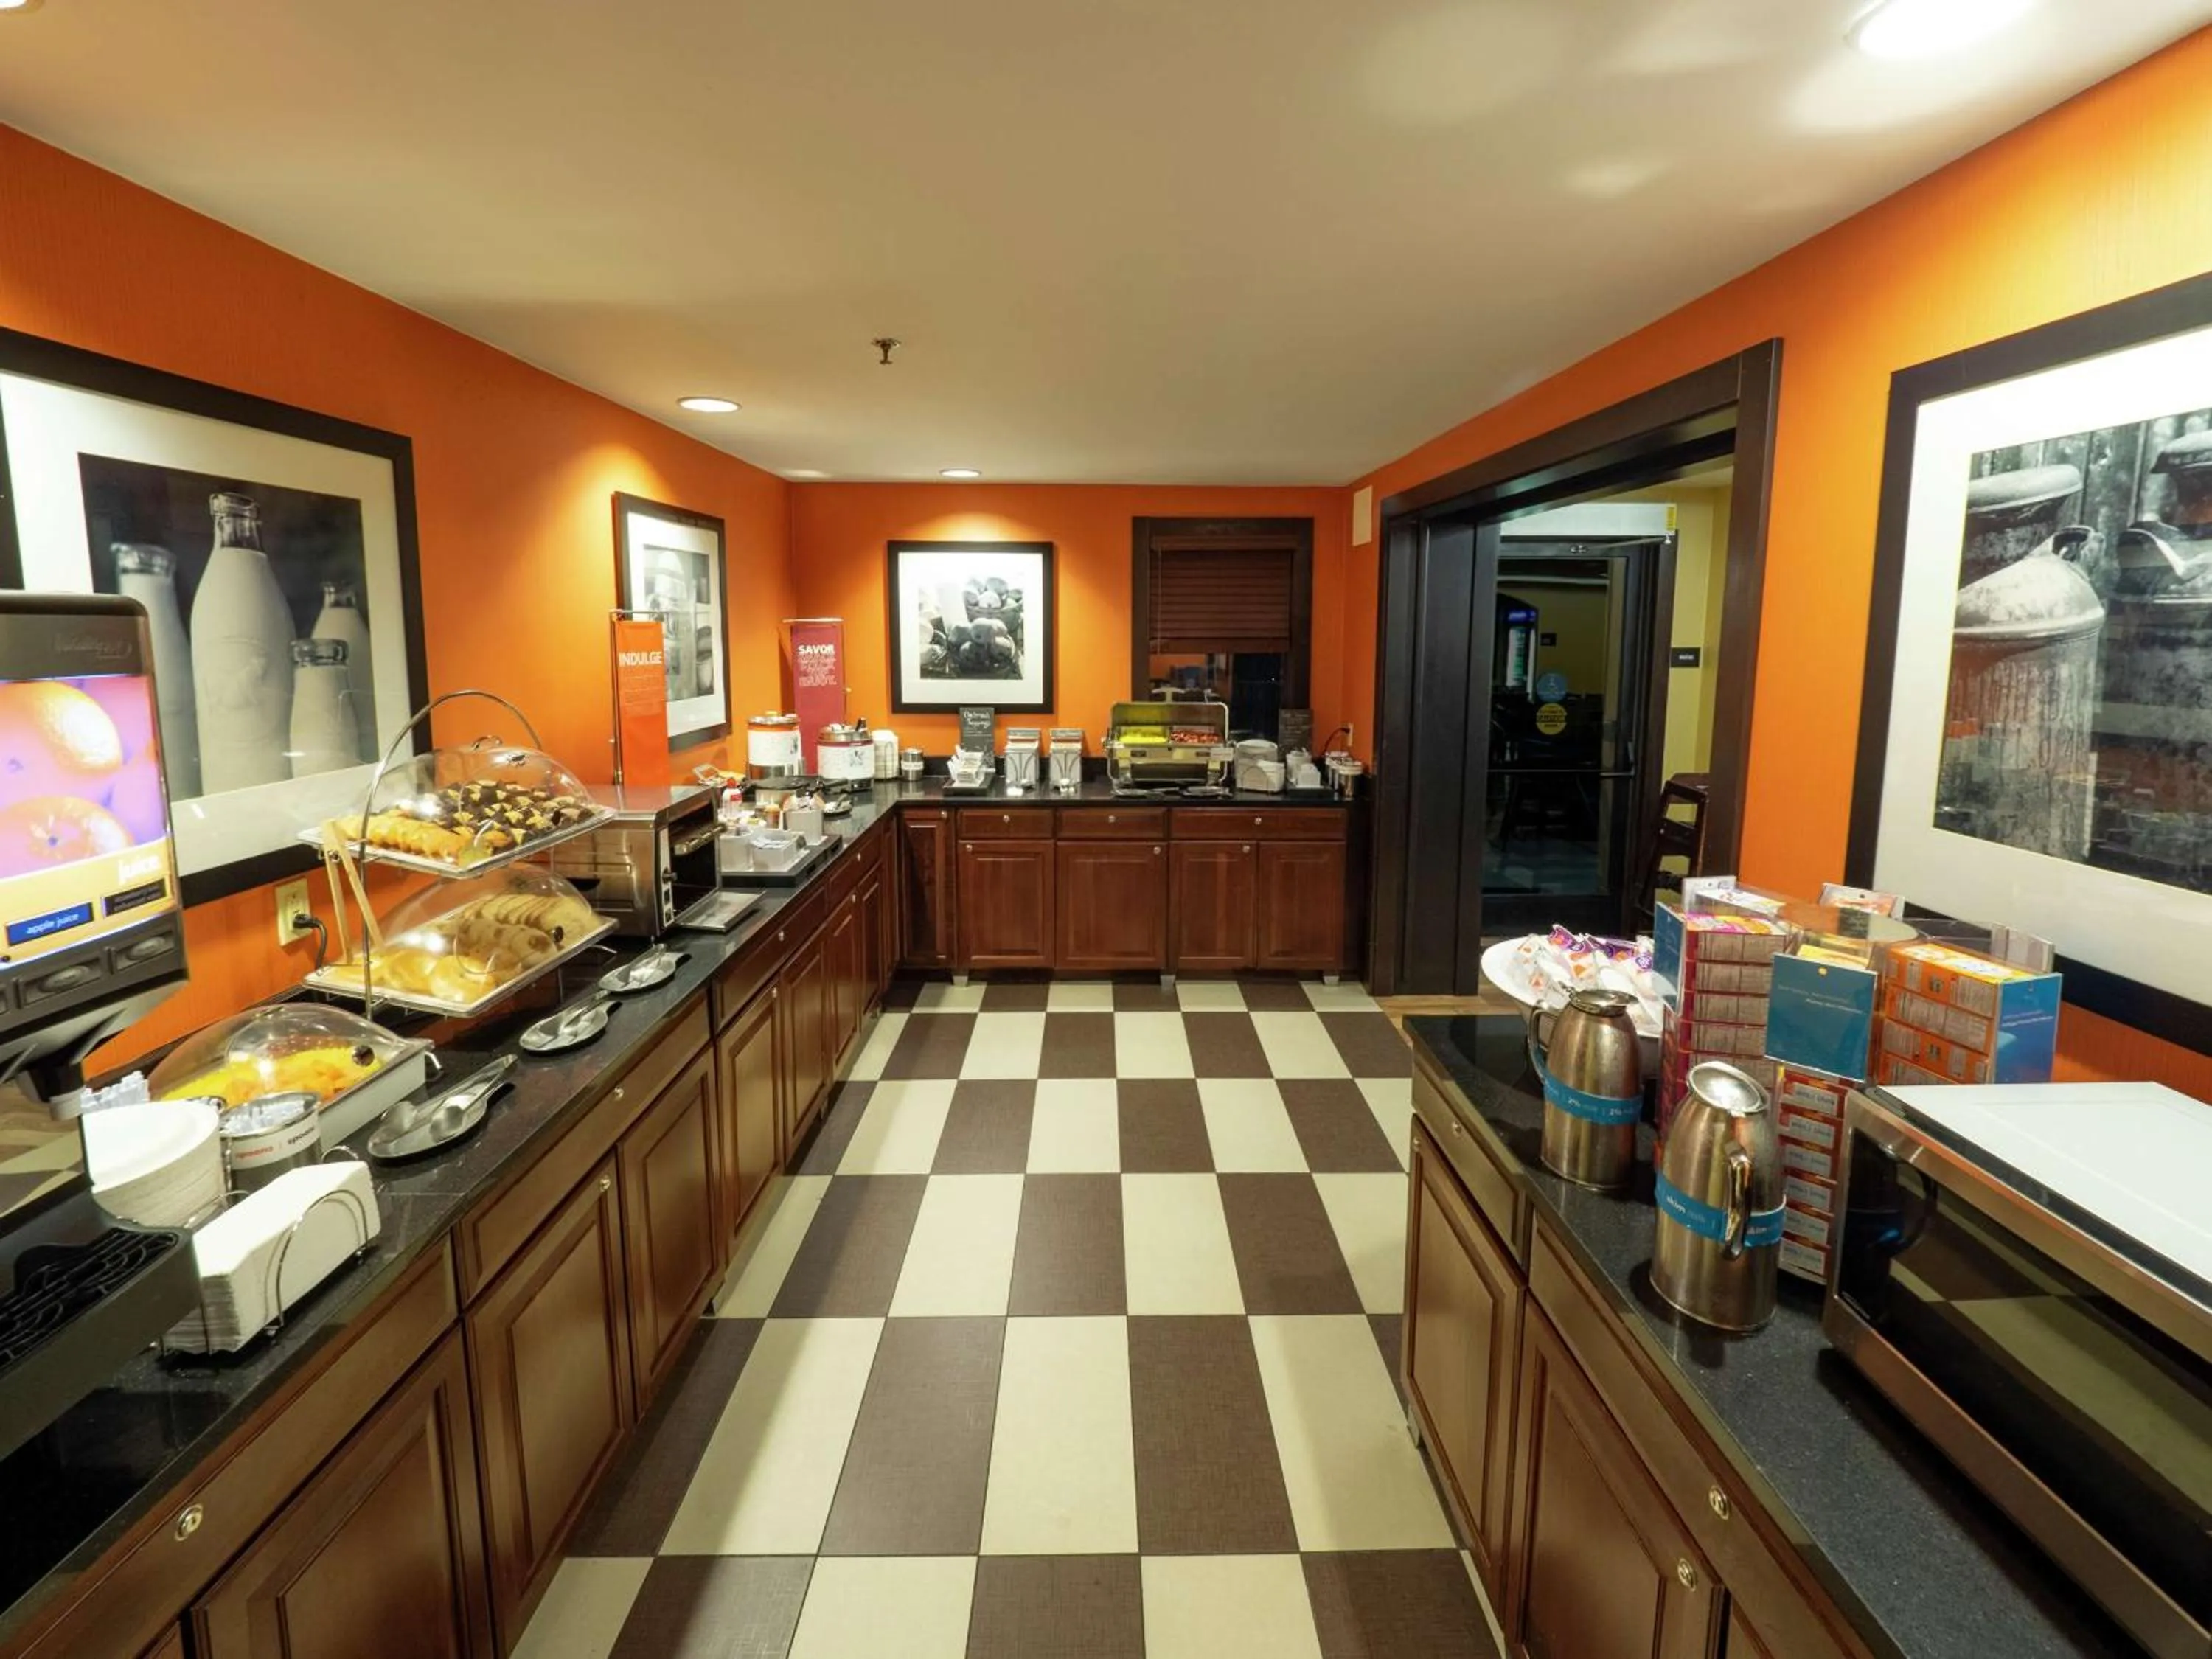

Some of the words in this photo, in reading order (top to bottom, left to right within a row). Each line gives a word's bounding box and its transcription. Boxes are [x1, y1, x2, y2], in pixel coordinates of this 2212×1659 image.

[619, 651, 662, 667] INDULGE
[798, 644, 835, 655] SAVOR
[118, 854, 161, 886] juice
[26, 919, 55, 936] apple
[56, 914, 80, 929] juice
